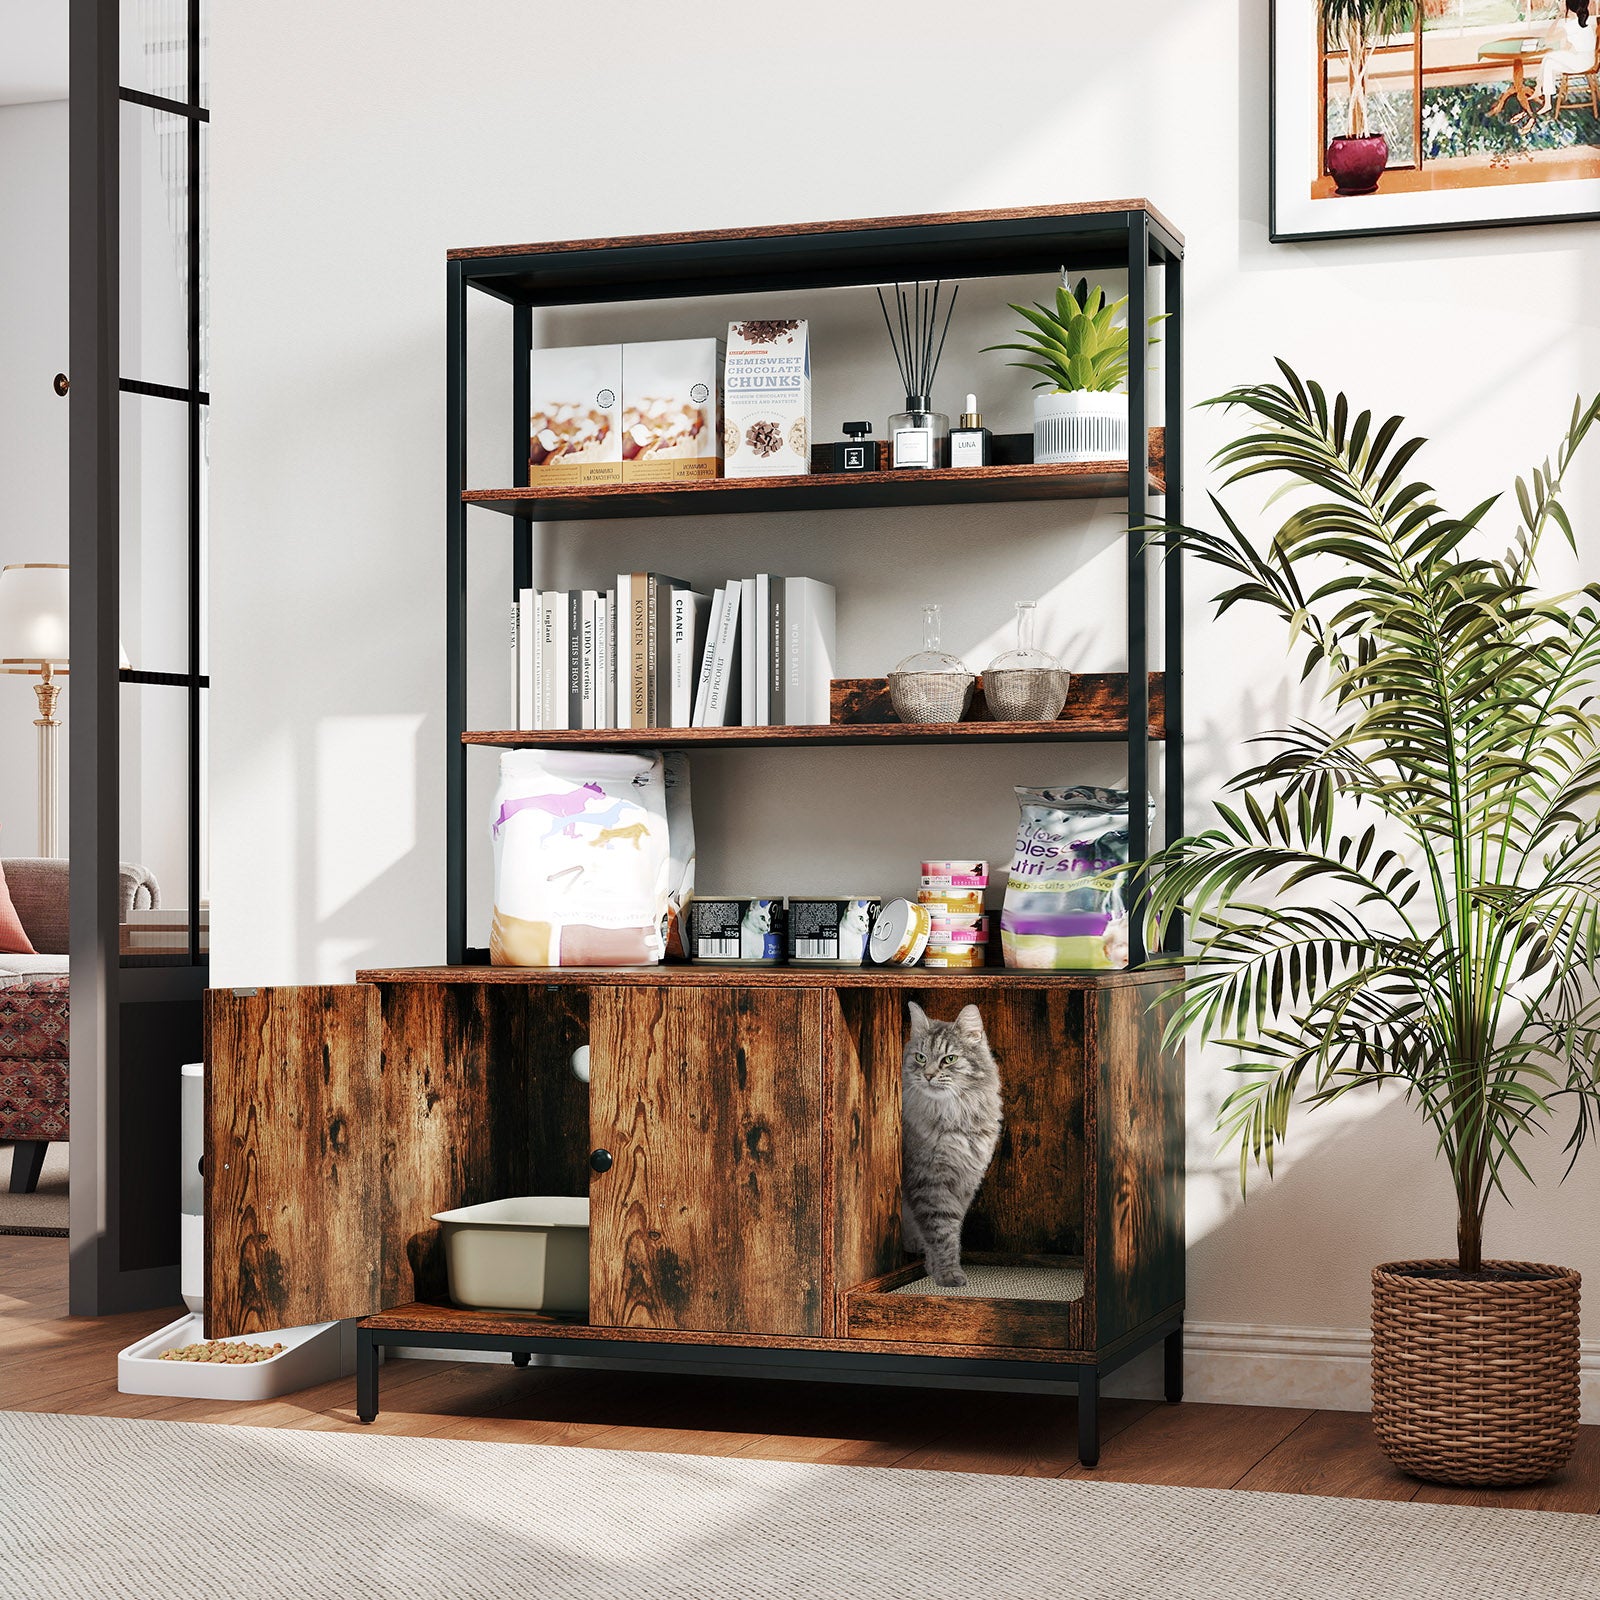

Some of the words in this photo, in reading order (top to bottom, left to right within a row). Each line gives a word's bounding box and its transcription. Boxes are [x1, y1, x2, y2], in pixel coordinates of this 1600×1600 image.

[728, 357, 802, 365] SEMISWEET
[728, 366, 800, 374] CHOCOLATE
[728, 376, 800, 388] CHUNKS
[572, 657, 578, 666] IS
[702, 642, 715, 684] SCHIELE
[713, 657, 724, 690] PICOULT
[635, 653, 643, 714] H.W.JANSON
[710, 692, 719, 709] JODI
[1033, 828, 1064, 841] love
